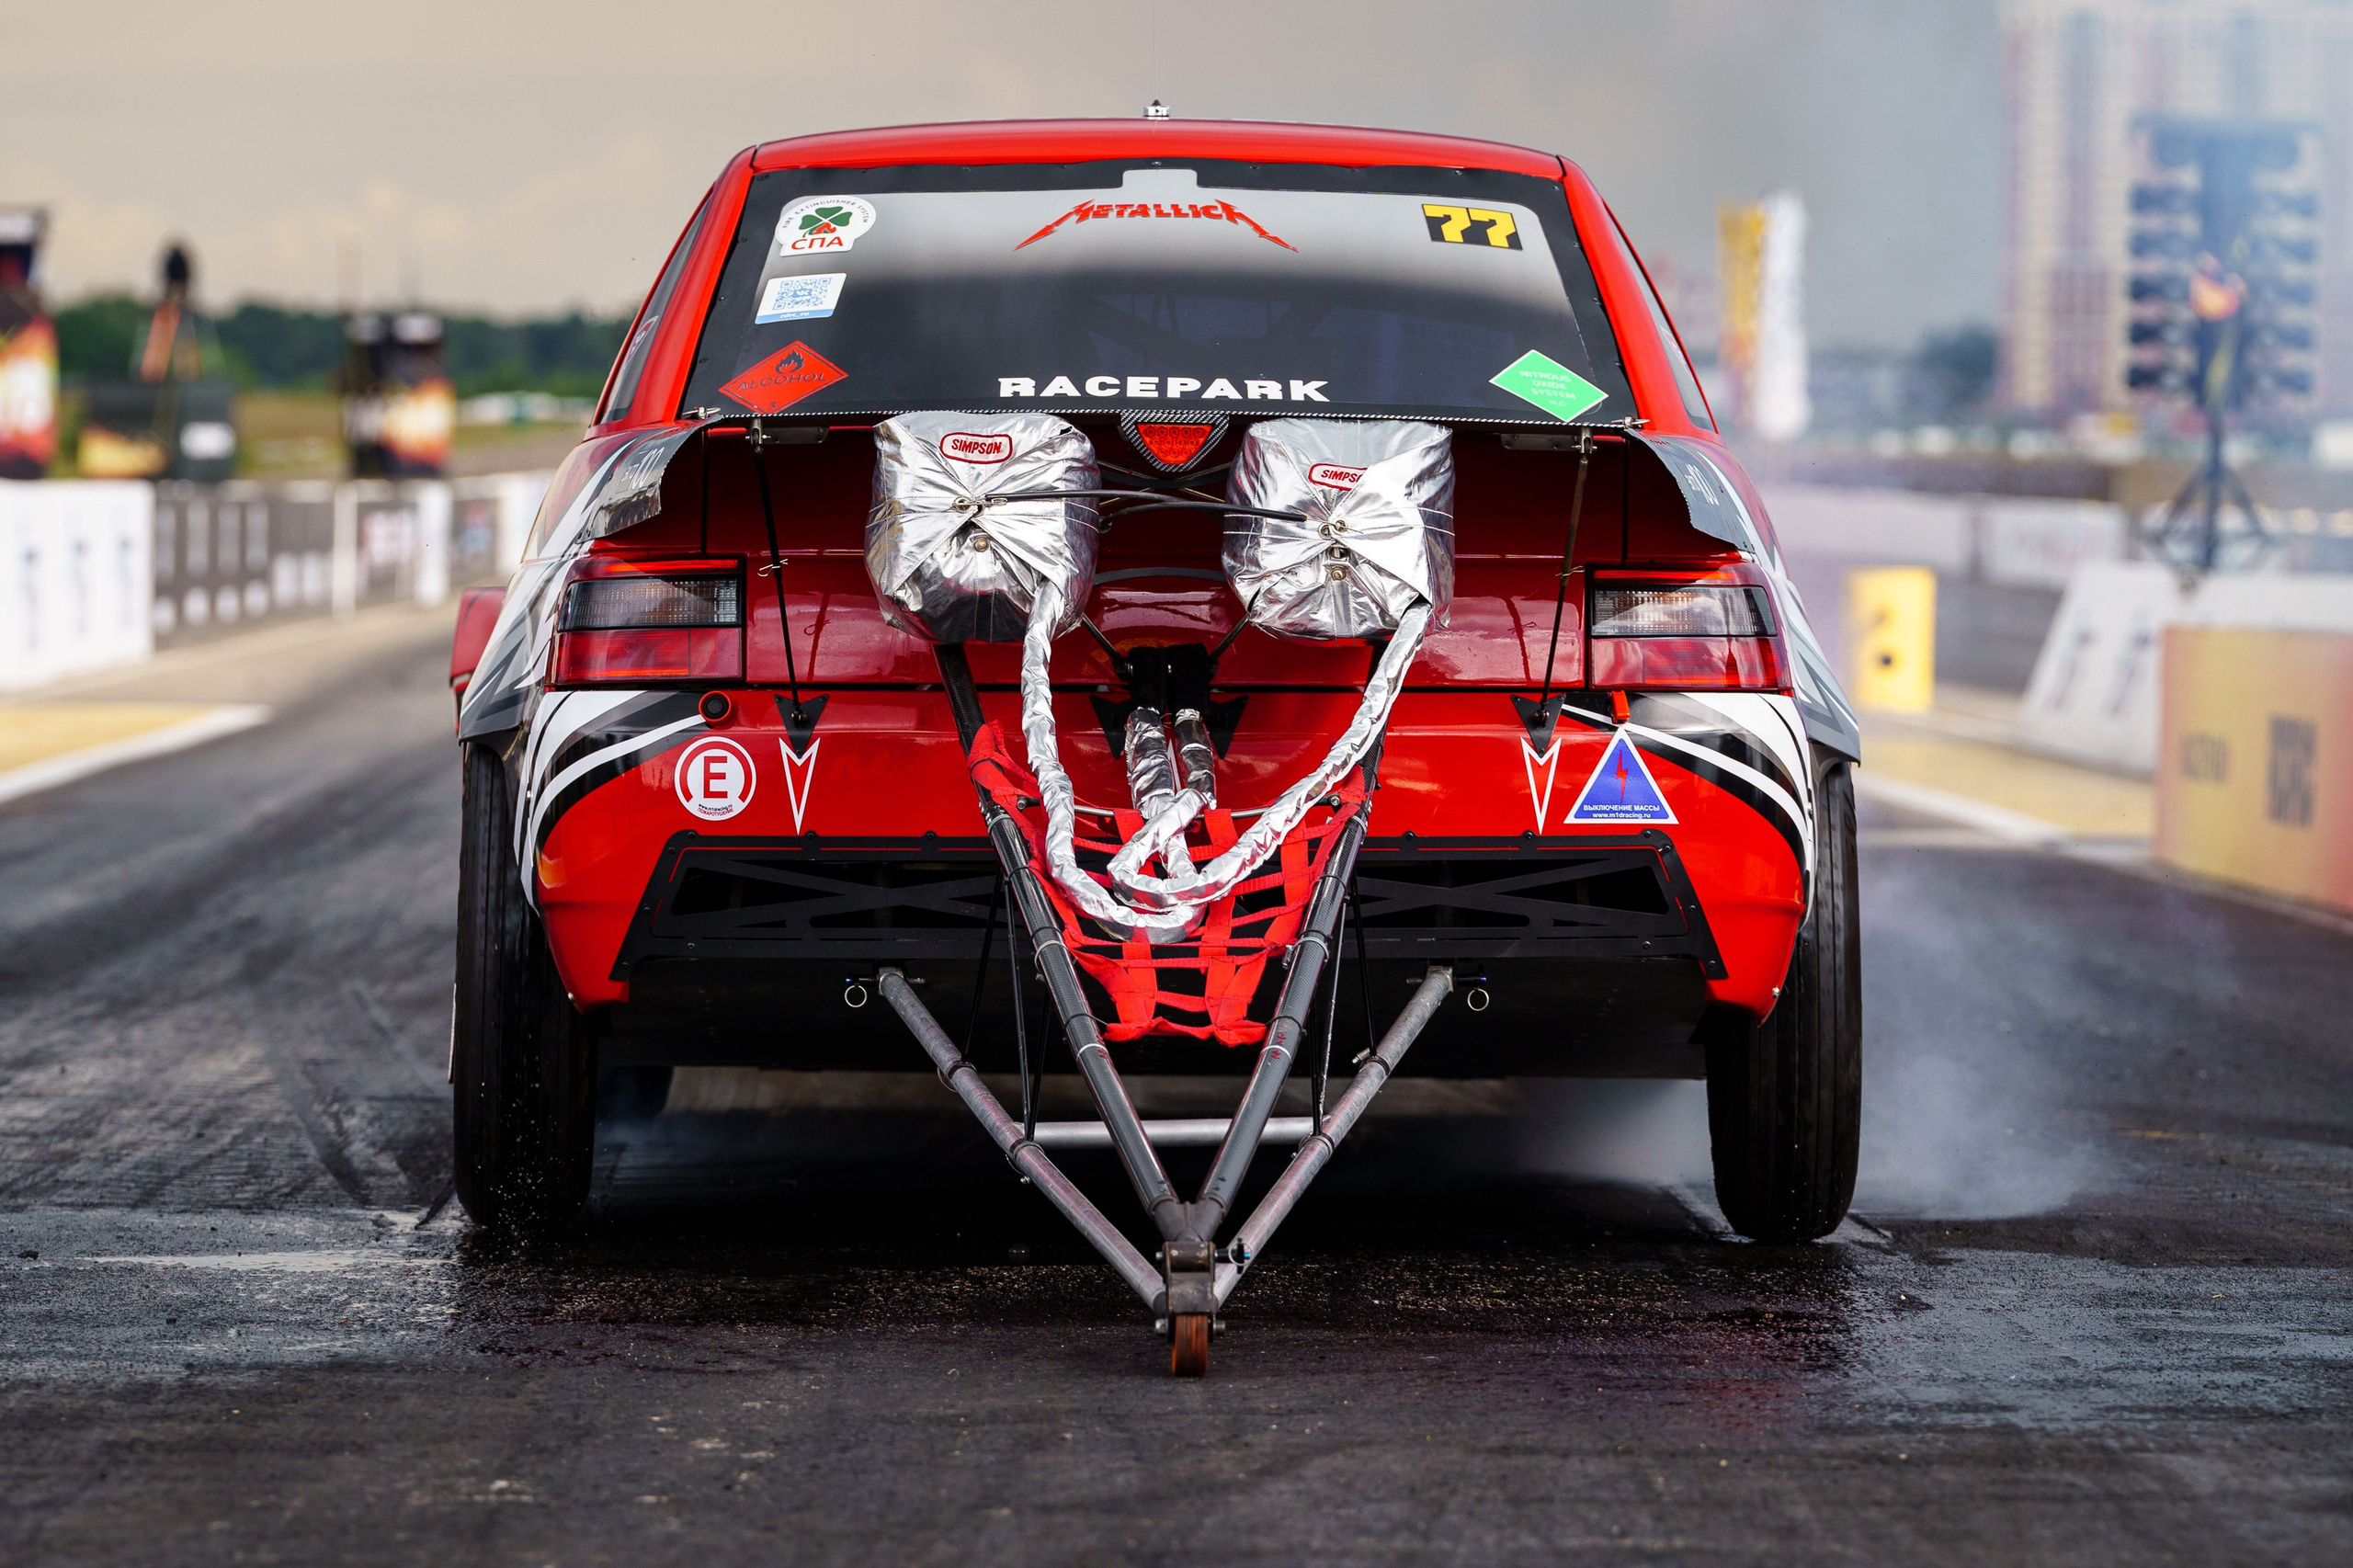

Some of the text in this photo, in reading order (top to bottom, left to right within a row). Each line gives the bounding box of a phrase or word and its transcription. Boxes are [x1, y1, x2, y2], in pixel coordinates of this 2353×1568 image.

[857, 205, 870, 223] SYSTEM
[1013, 199, 1300, 253] METALLICA
[1422, 204, 1517, 248] 77
[791, 236, 844, 250] СПА
[737, 372, 827, 392] ALCOHOL
[1519, 370, 1572, 382] NITROUS
[998, 375, 1330, 402] RACEPARK
[1530, 387, 1576, 399] SYSTEM
[1531, 380, 1567, 391] OXIDE
[767, 402, 778, 411] 3
[951, 438, 1003, 455] SIMPSON
[703, 756, 728, 798] E
